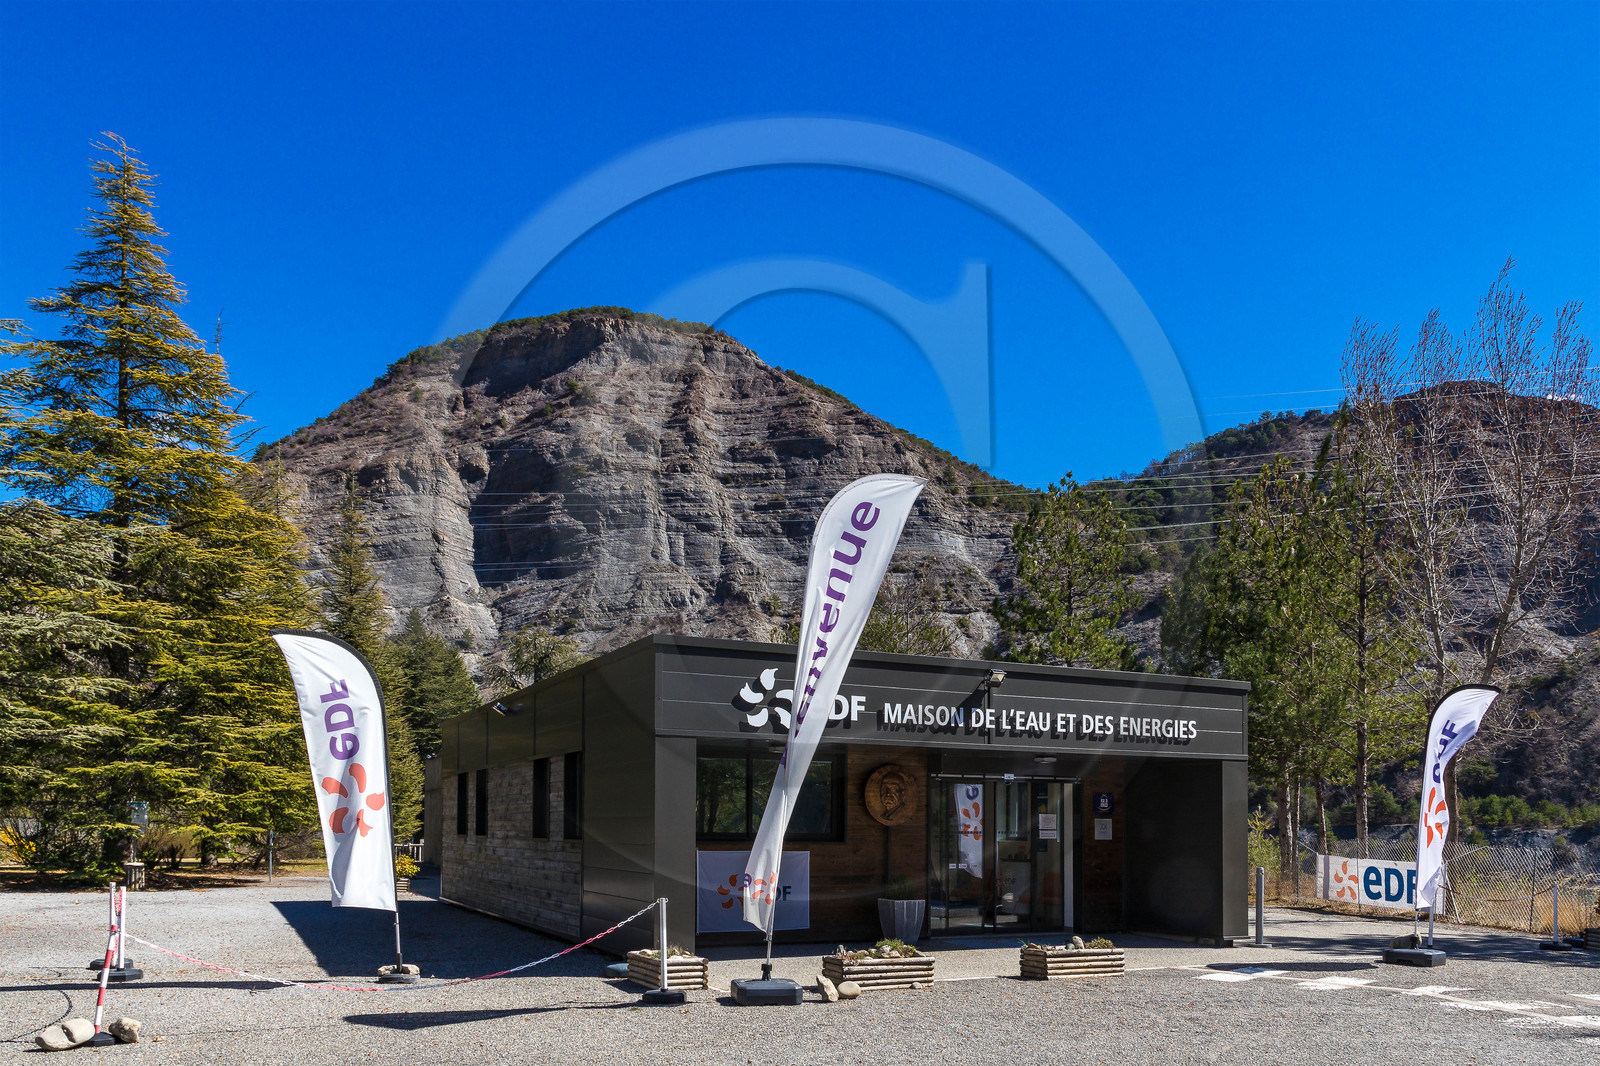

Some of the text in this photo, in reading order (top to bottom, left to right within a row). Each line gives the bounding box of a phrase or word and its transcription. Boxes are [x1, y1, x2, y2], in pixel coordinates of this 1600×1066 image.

[829, 694, 1197, 739] DF MAISON DE L'EAU ET DES ENERGIES
